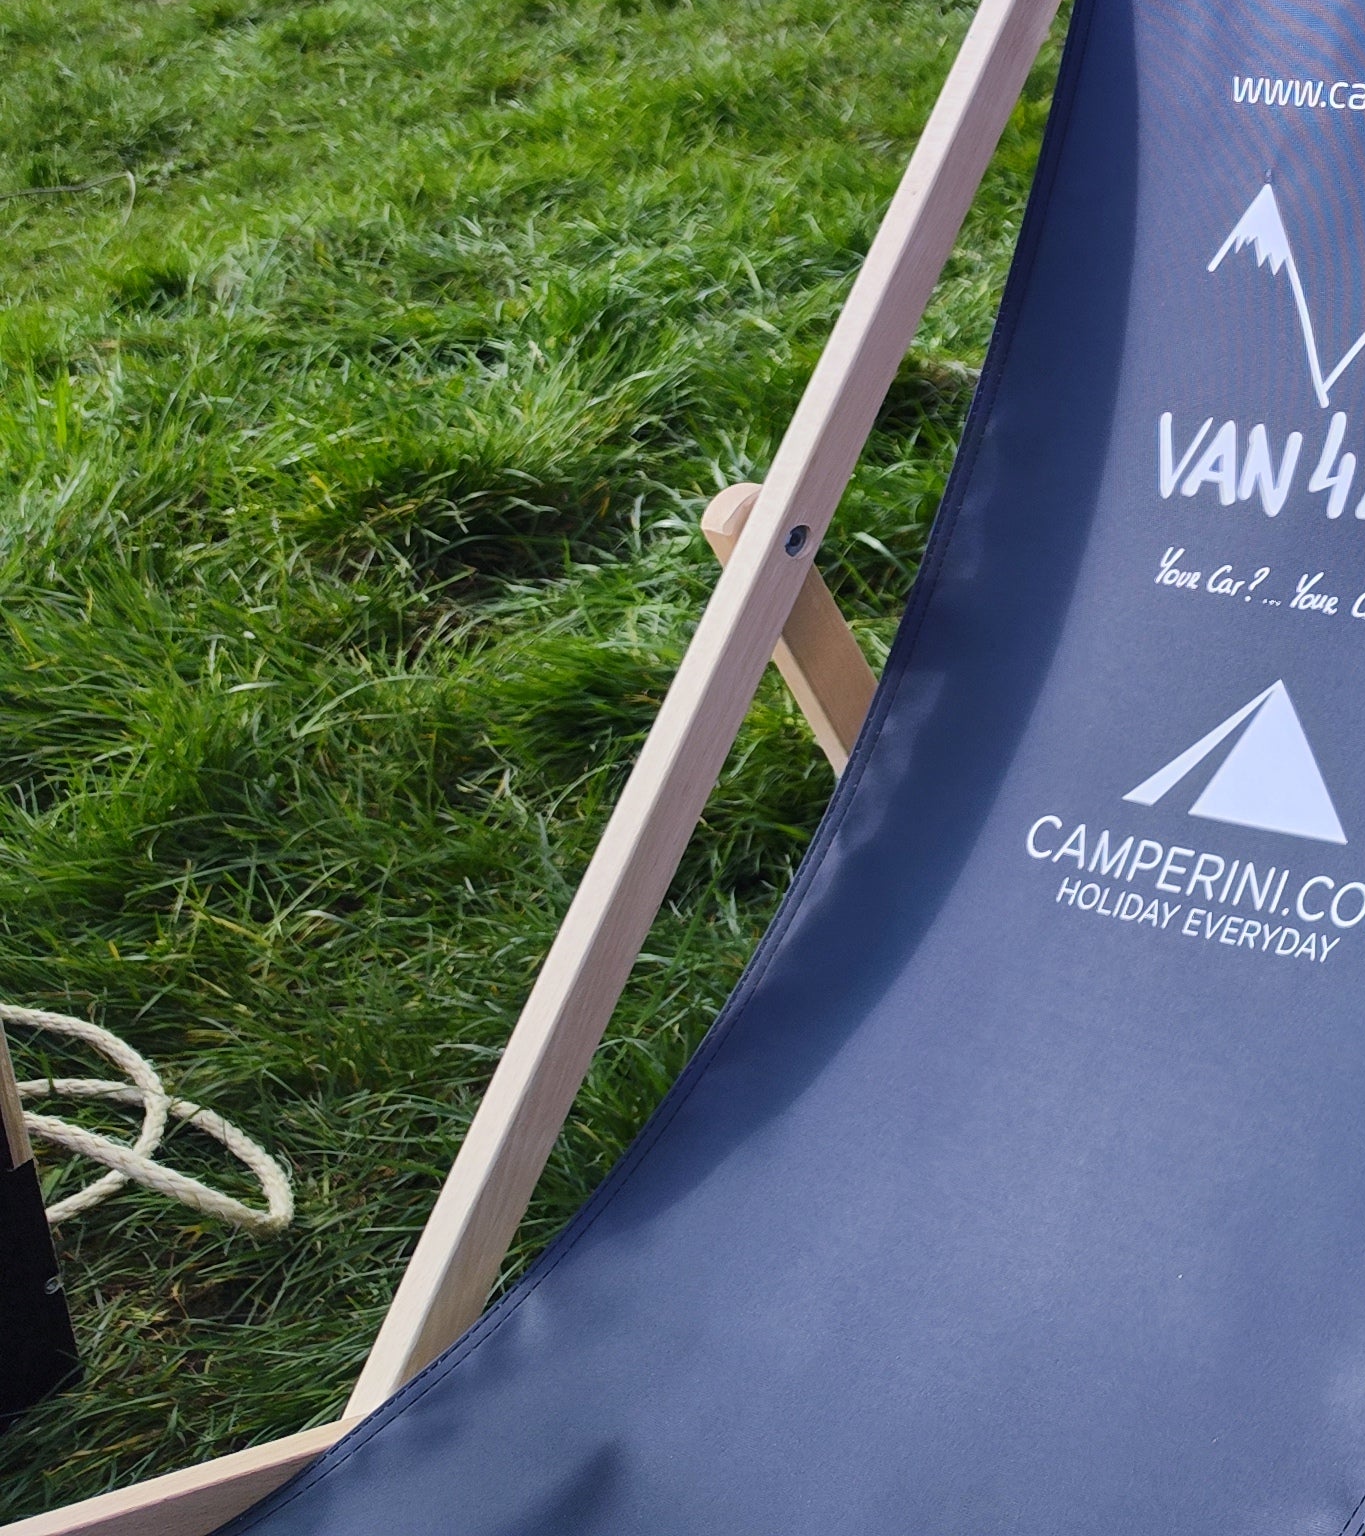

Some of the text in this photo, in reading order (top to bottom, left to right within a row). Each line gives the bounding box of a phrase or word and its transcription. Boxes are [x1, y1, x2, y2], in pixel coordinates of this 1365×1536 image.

[1159, 412, 1303, 517] VAN
[1308, 412, 1356, 519] 4
[1055, 876, 1341, 963] HOLIDAY EVERYDAY
